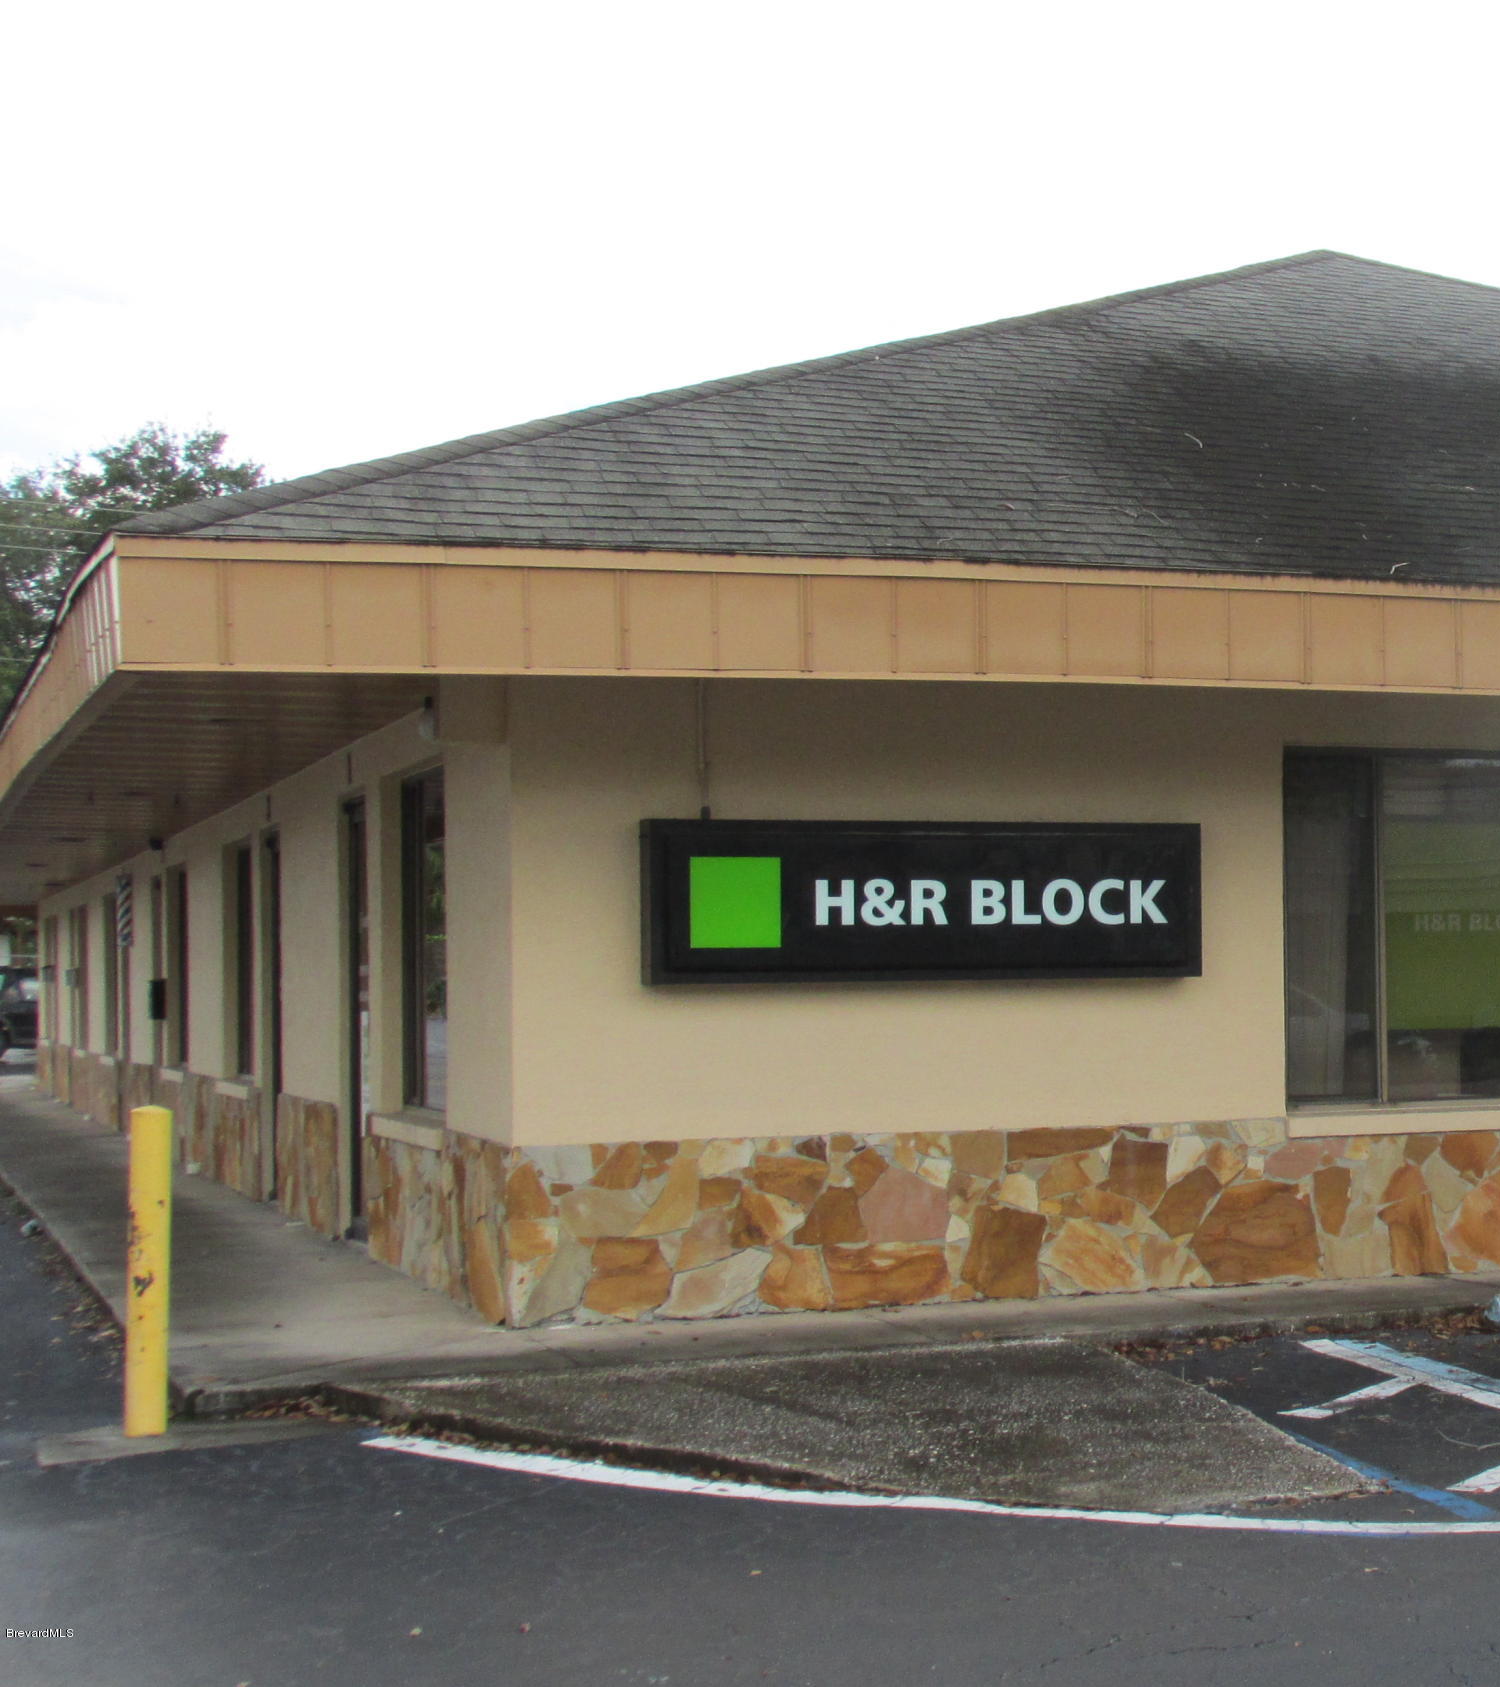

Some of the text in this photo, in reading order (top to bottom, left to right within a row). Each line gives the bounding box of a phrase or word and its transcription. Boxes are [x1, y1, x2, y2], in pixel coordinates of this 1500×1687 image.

[815, 879, 1168, 926] H&R BLOCK
[1414, 913, 1461, 931] H&R
